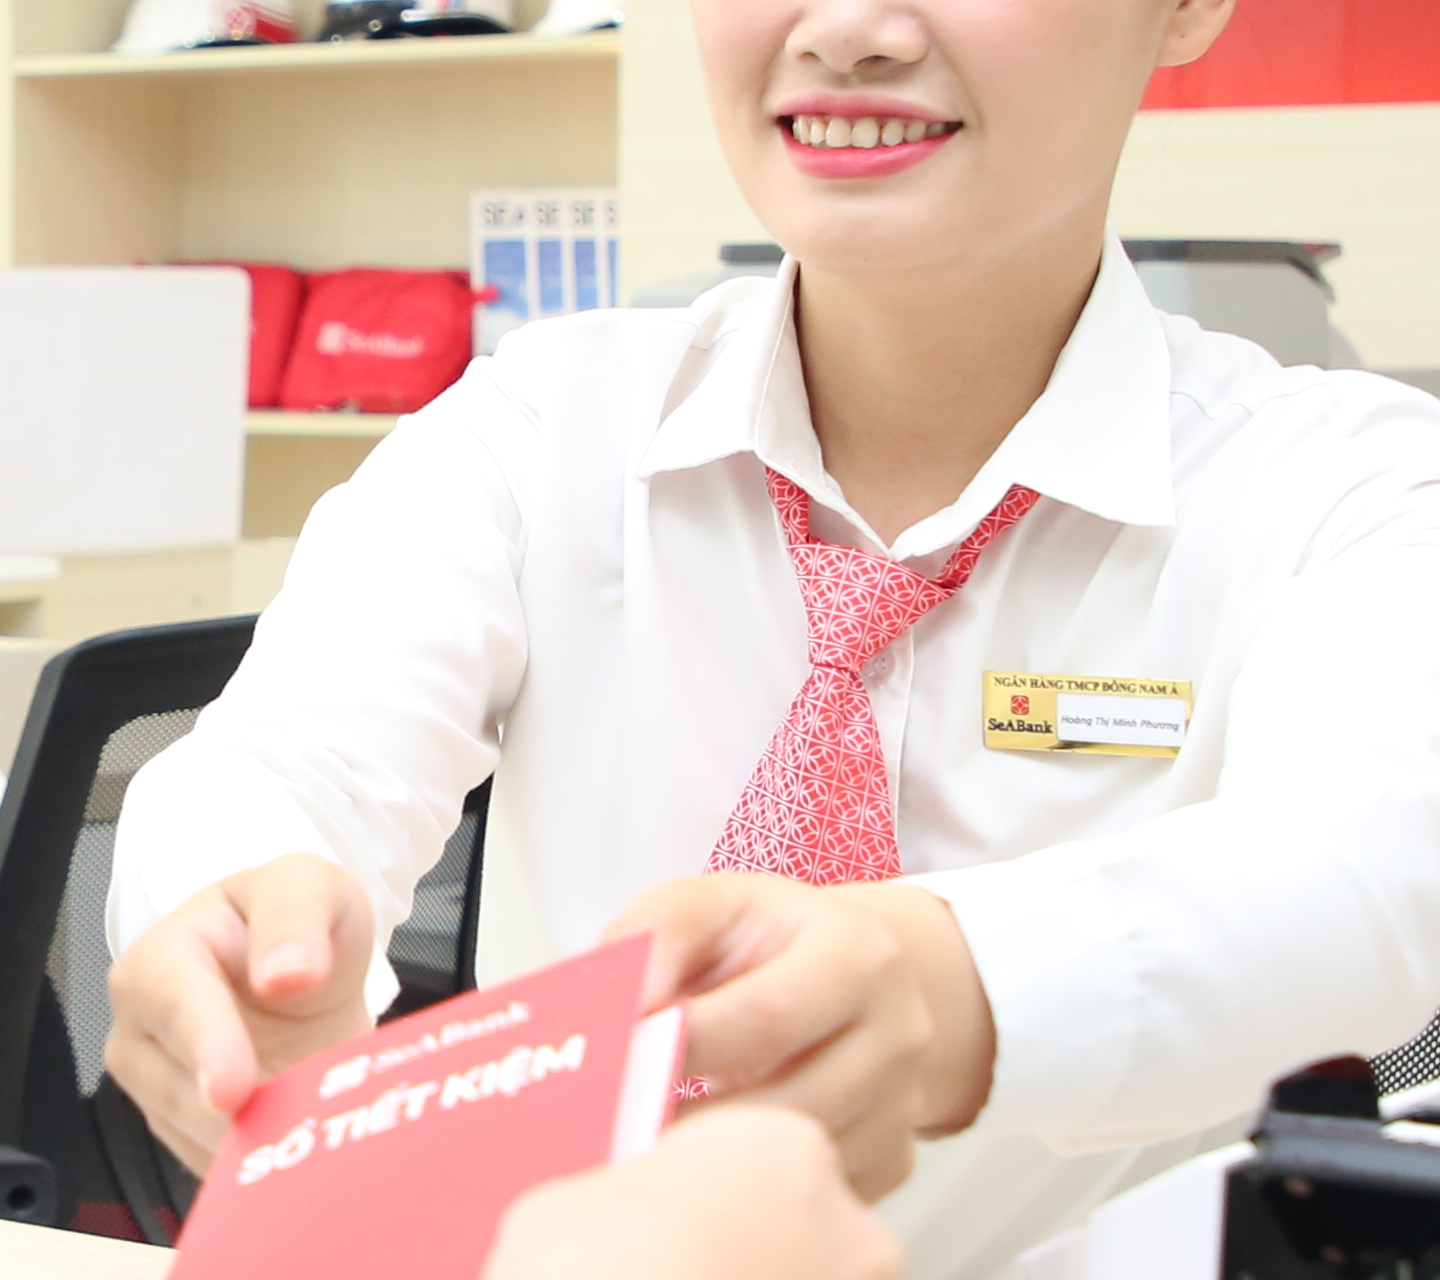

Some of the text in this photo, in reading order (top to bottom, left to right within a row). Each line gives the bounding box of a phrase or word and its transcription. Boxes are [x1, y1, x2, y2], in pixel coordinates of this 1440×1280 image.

[993, 675, 1028, 689] NGÂN
[1029, 676, 1065, 691] HÀNG
[1066, 680, 1100, 694] TMCP
[1102, 679, 1137, 695] ĐÔNG
[1138, 684, 1167, 697] NAM
[987, 717, 1054, 734] SeABank
[1111, 718, 1138, 729] Minh
[371, 1000, 532, 1074] SeABank
[322, 1079, 439, 1149] TIẾT
[437, 1033, 587, 1110] KIỆM
